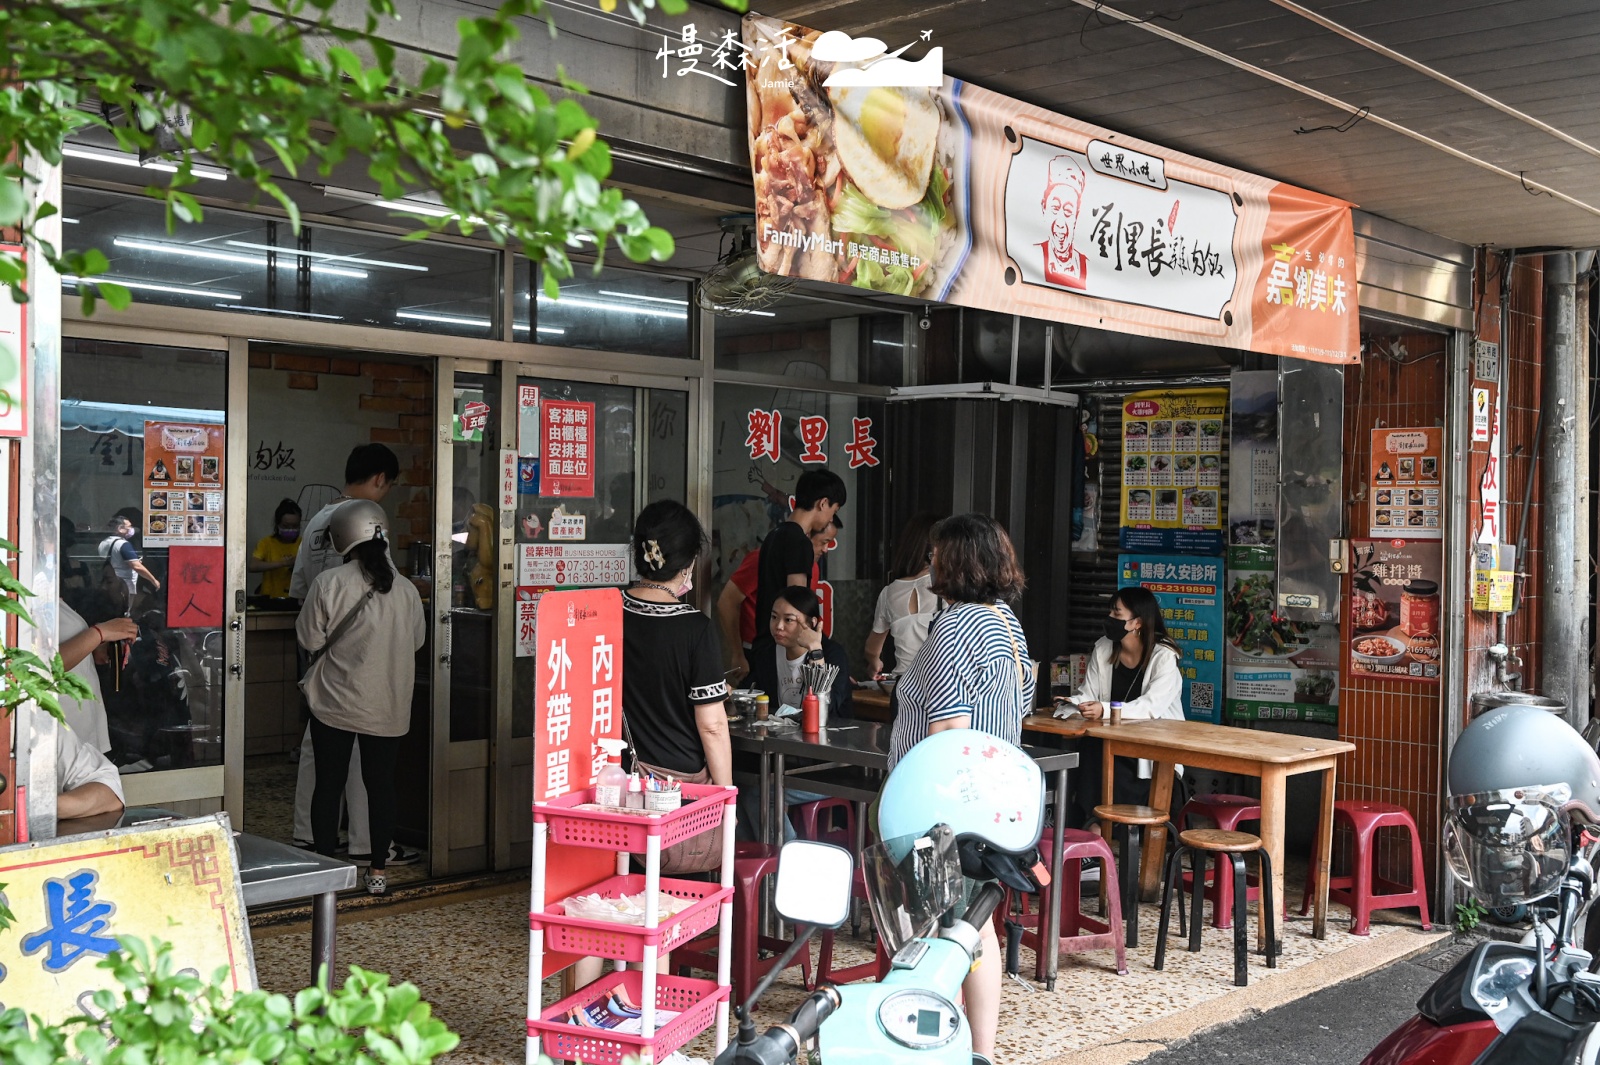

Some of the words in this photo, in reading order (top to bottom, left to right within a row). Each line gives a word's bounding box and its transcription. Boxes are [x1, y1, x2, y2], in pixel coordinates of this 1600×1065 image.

[763, 223, 844, 256] FamilyMart
[847, 241, 921, 270] 限定商品販售中
[1482, 360, 1496, 378] 197
[549, 407, 588, 425] 客滿時
[549, 425, 588, 442] 由櫃檯
[745, 408, 880, 469] 劉里長
[249, 440, 296, 470] 肉飯
[549, 442, 588, 459] 安排裡
[549, 459, 588, 476] 面座位
[504, 453, 514, 505] 請先付款
[525, 546, 563, 557] 營業時間
[564, 549, 595, 557] BUSINESS
[566, 560, 626, 571] 07:30-14:30
[1140, 562, 1217, 582] 腸痔久安診所
[1372, 563, 1423, 579] 雞拌醬
[567, 572, 626, 583] 16:30-19:00
[1149, 584, 1213, 594] 05-2319898
[781, 677, 803, 687] LEMO
[545, 638, 573, 798] 外帶單
[20, 868, 125, 973] 長
